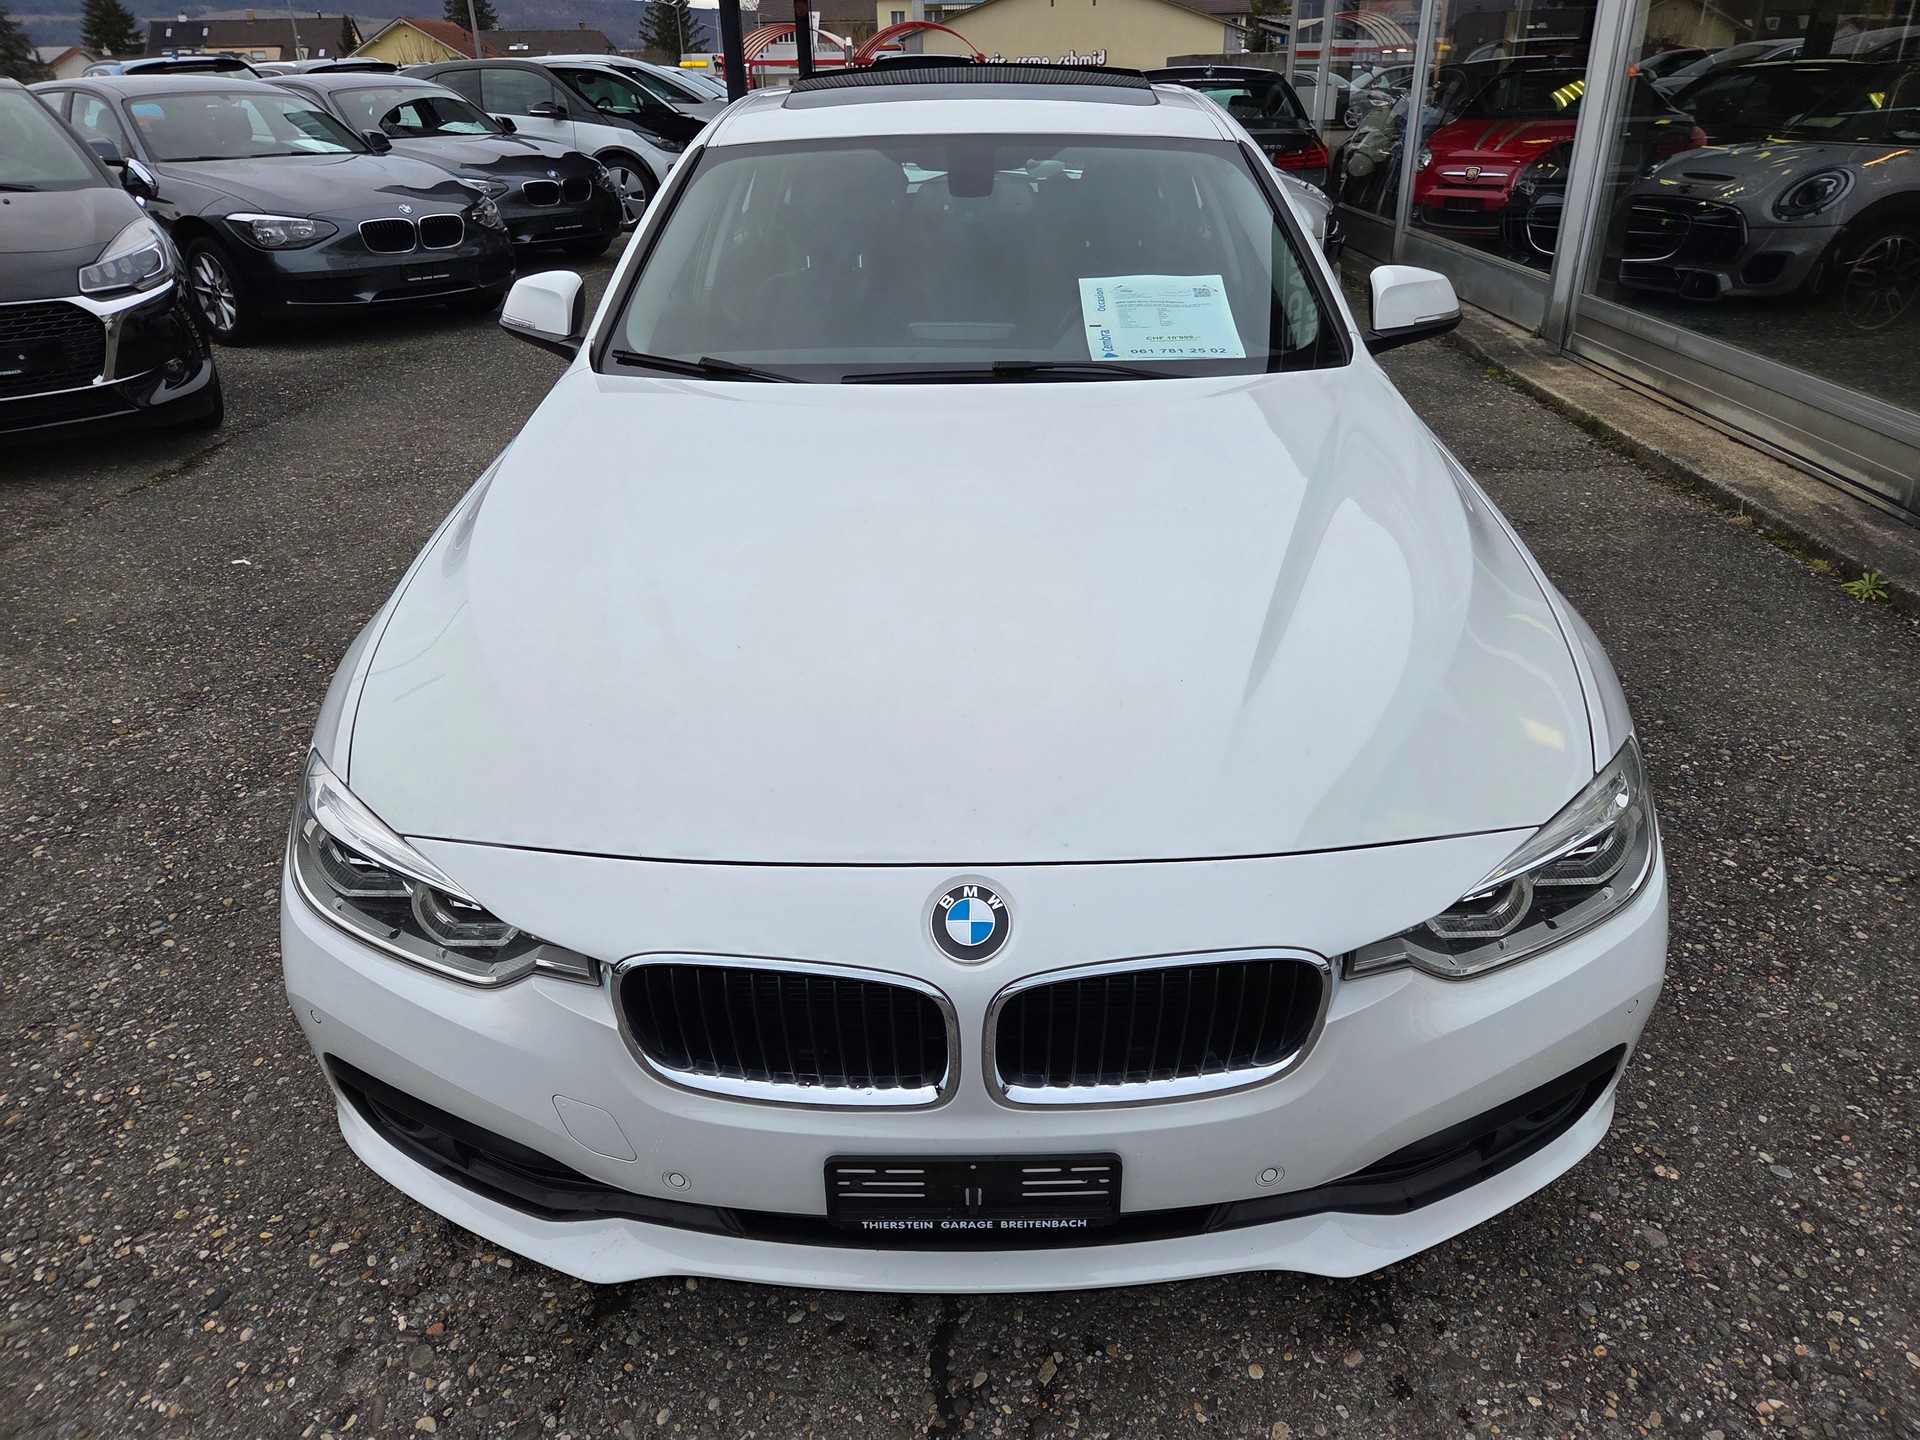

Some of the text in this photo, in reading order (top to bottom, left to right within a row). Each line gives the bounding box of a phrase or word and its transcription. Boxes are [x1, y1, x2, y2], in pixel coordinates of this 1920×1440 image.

[1056, 49, 1107, 66] schmid
[1096, 287, 1106, 312] Occasion
[1098, 329, 1114, 352] Cembra
[939, 886, 1003, 910] BMW
[861, 1219, 1088, 1230] THIERSTEIN GARAGE BREITENBACH
